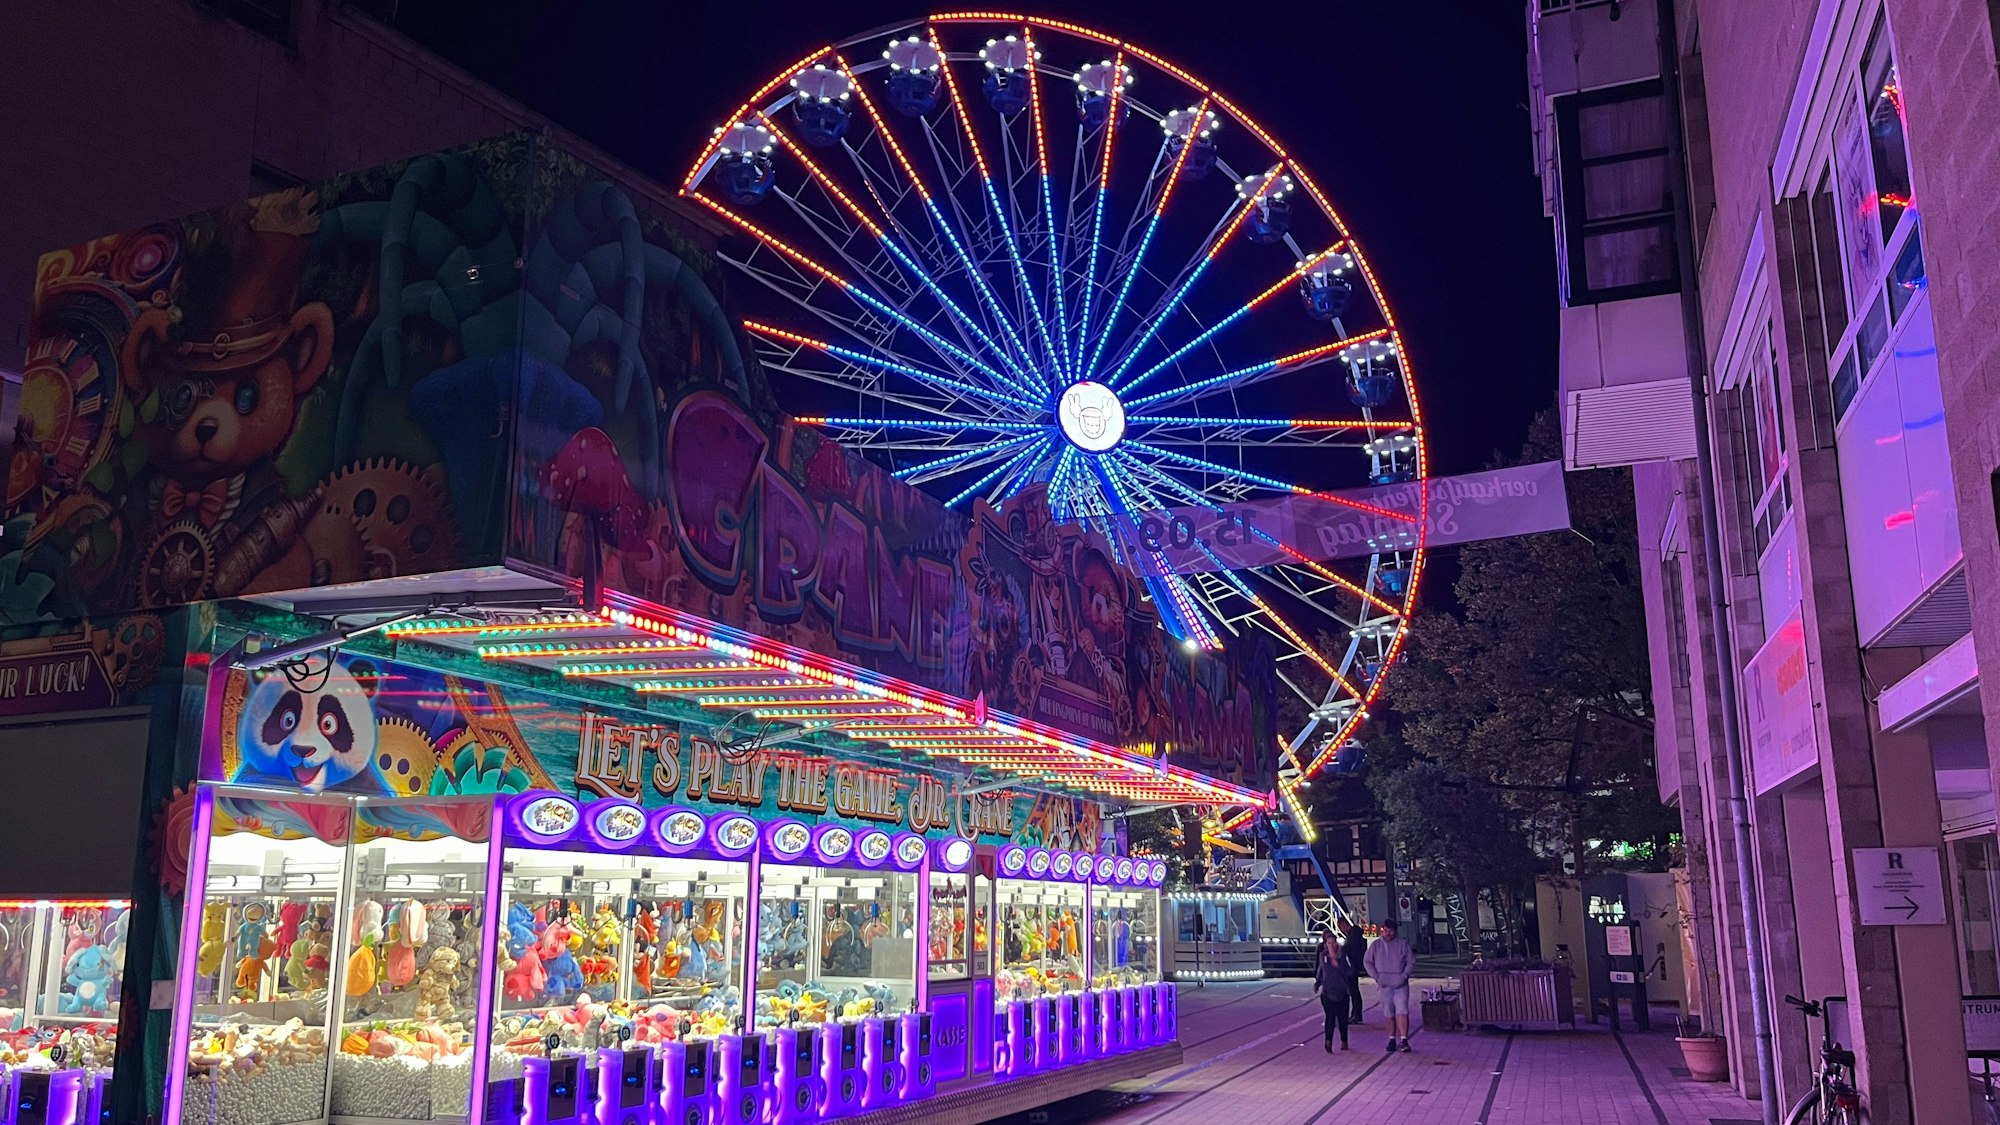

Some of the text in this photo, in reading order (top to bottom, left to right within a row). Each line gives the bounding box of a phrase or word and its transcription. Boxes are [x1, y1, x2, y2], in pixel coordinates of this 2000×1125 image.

[667, 390, 955, 670] CRANE
[24, 654, 90, 697] LUCK!
[577, 709, 681, 805] LET'S
[687, 735, 770, 803] PLAY
[777, 755, 829, 811] THE
[834, 766, 904, 823] GAME,
[1887, 852, 1904, 869] R
